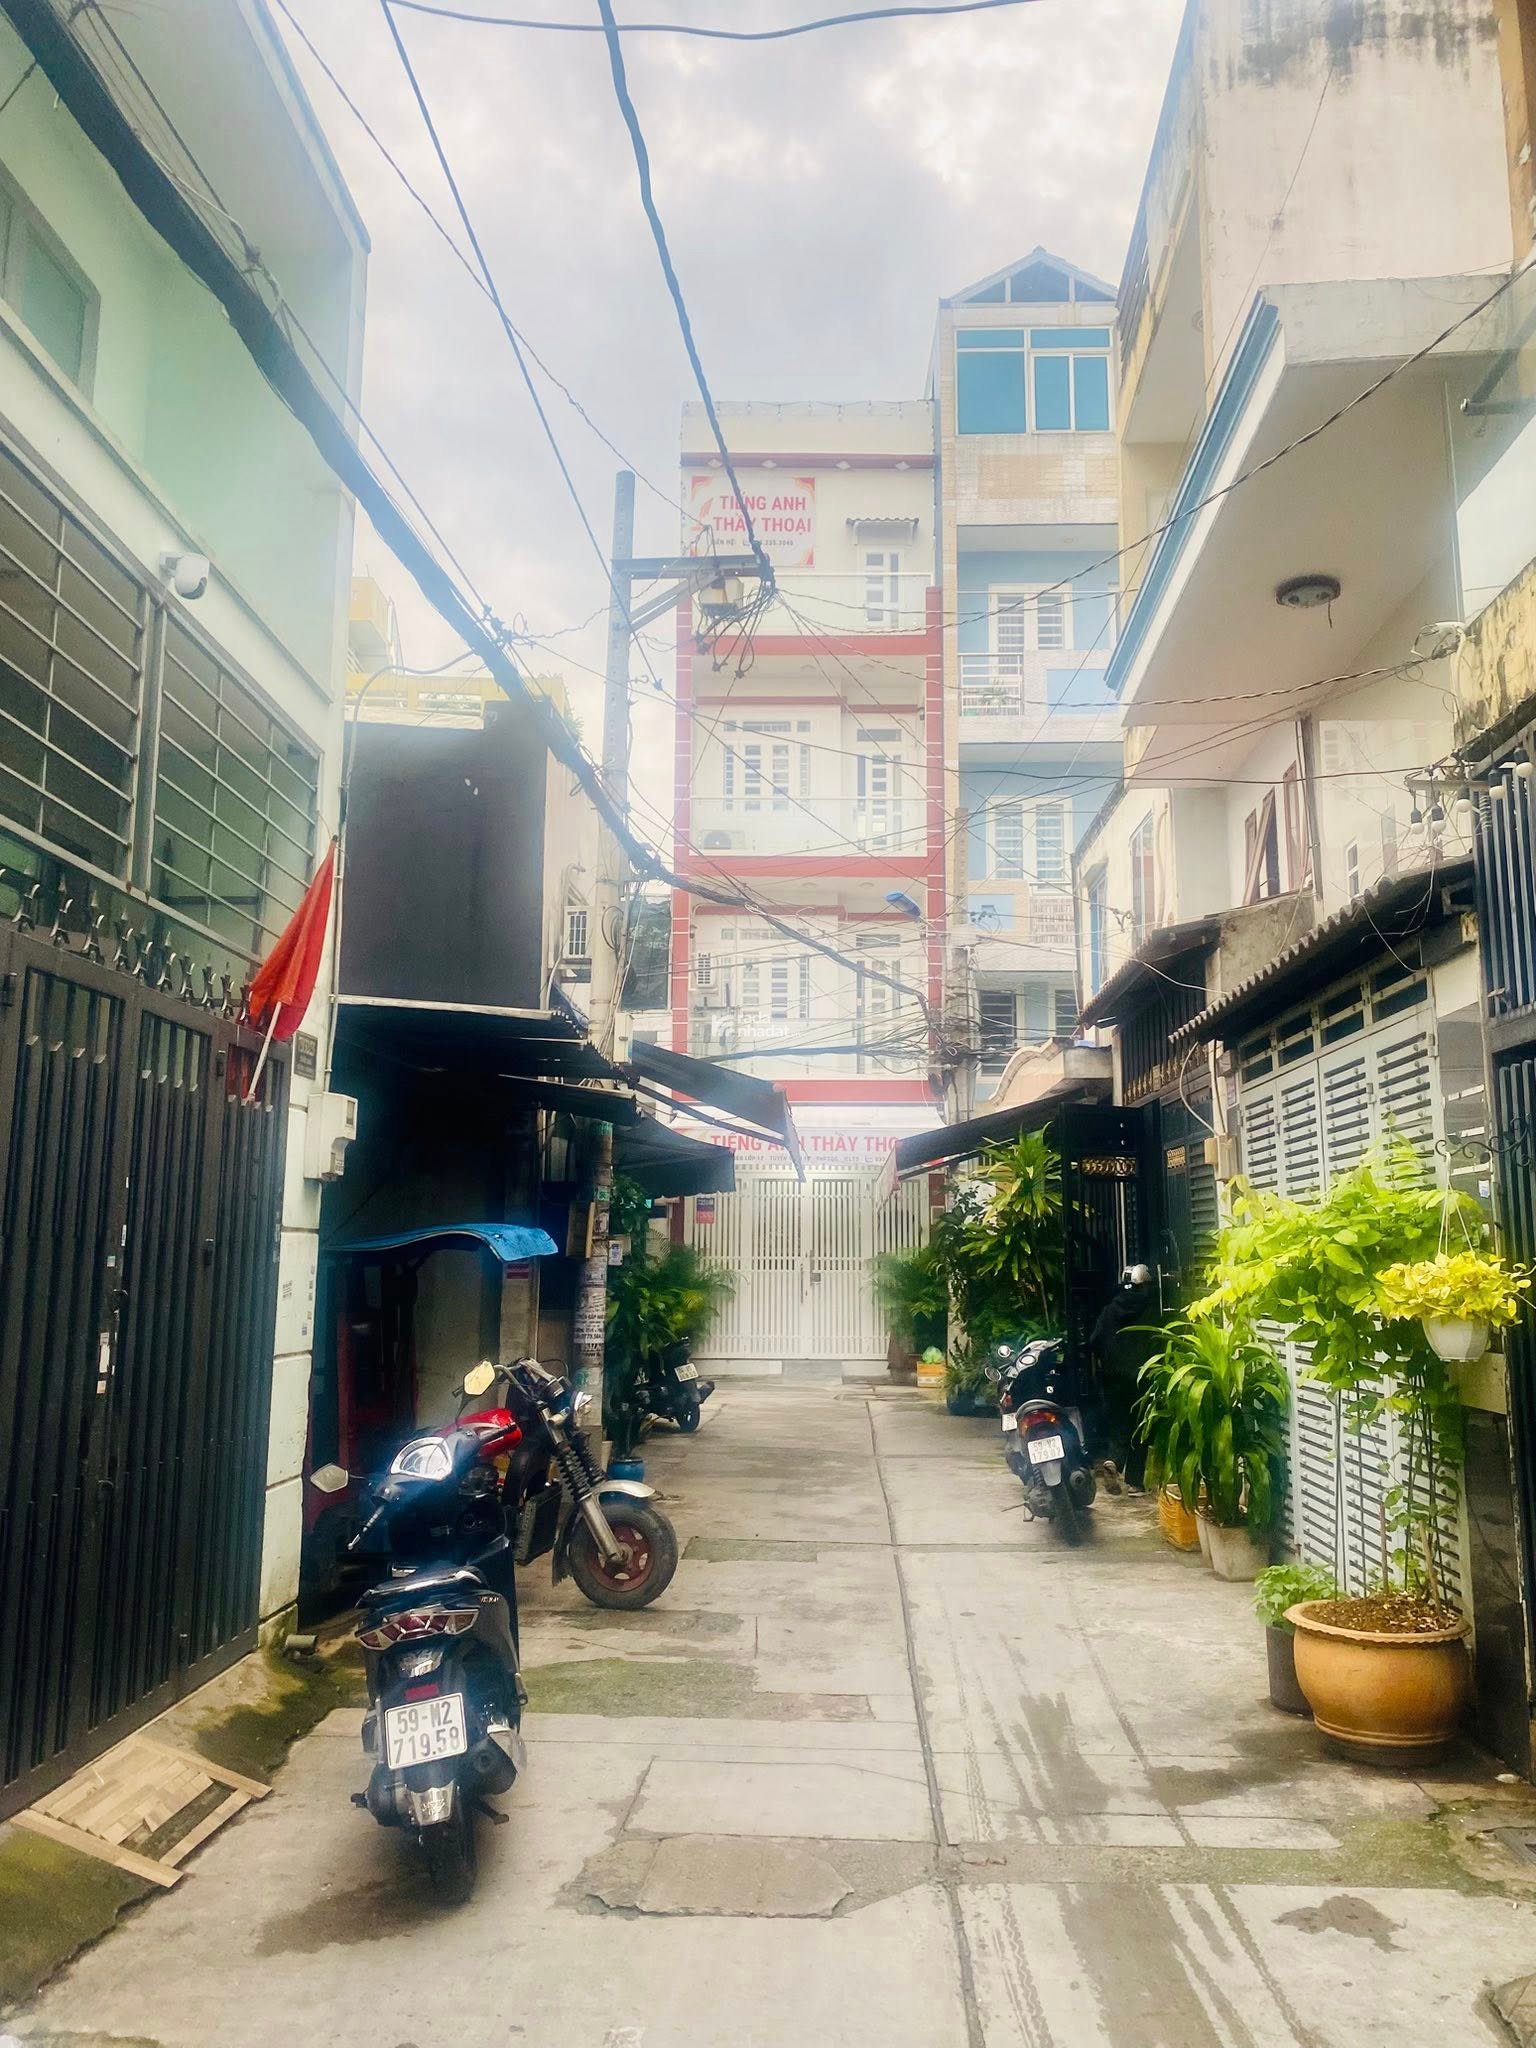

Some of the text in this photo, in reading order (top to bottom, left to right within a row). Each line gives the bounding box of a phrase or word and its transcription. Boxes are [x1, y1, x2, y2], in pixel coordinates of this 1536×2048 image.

[772, 496, 806, 511] ANH
[761, 517, 811, 535] THOẠI
[811, 1131, 858, 1151] THẦY
[864, 1136, 898, 1152] THO
[397, 1701, 453, 1734] 59-M2
[393, 1726, 460, 1764] 719.58
